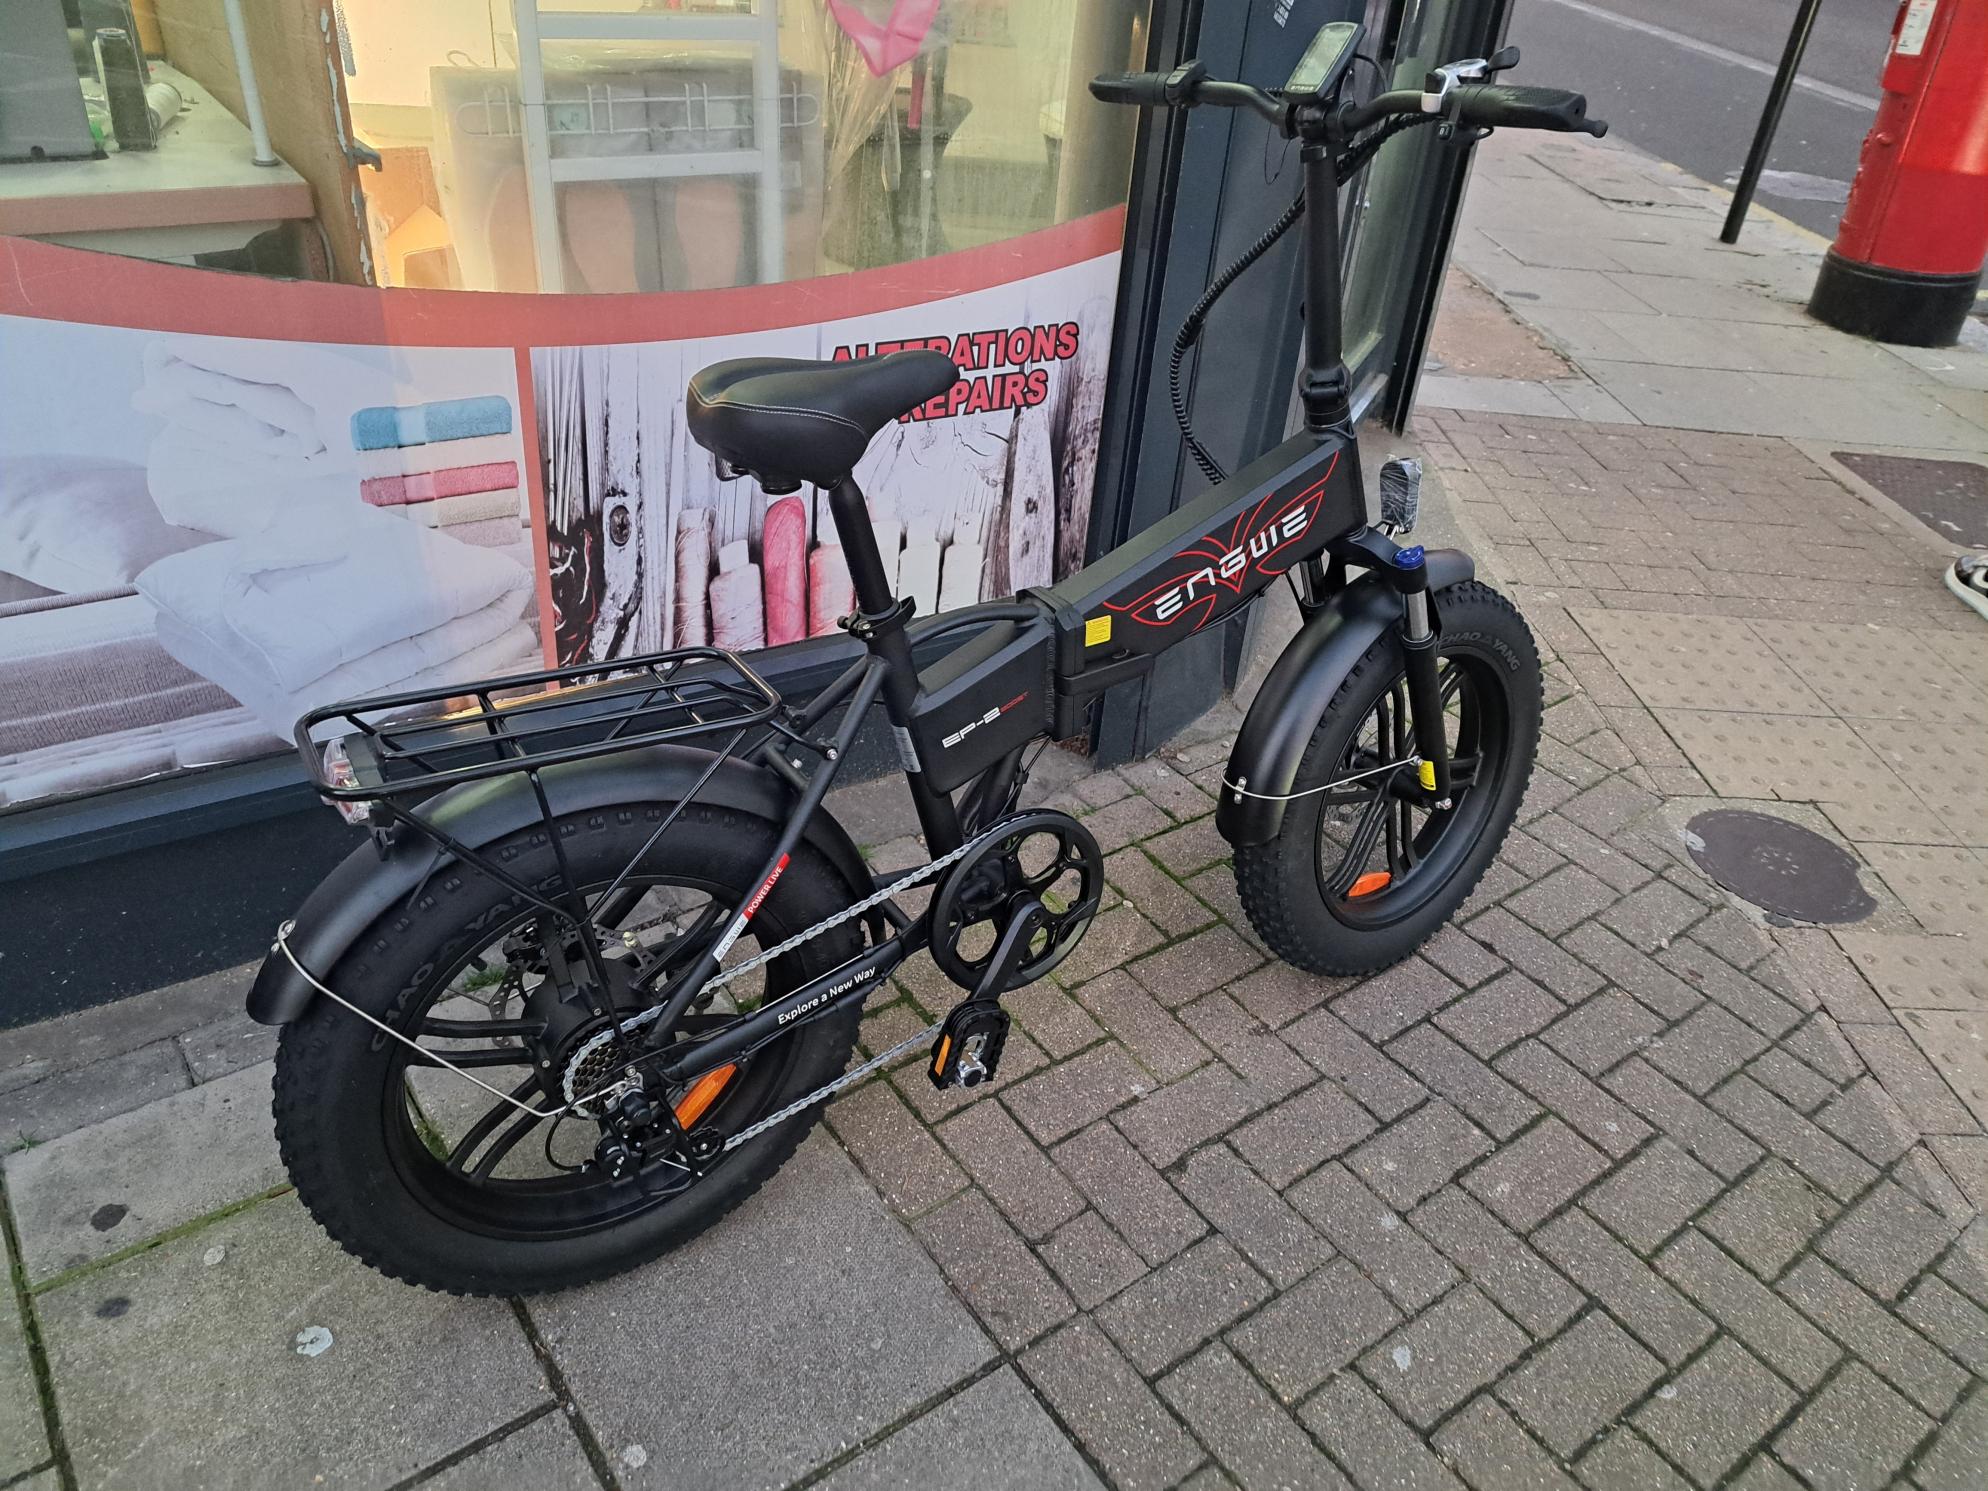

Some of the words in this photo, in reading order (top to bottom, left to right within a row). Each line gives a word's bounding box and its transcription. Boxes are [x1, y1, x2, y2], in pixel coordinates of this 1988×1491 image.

[1493, 639, 1521, 671] YANG
[748, 884, 771, 913] POWER
[768, 866, 783, 885] LIVE
[777, 998, 819, 1025] Explore
[821, 993, 828, 1002] a
[829, 979, 853, 998] New
[853, 966, 876, 984] Way
